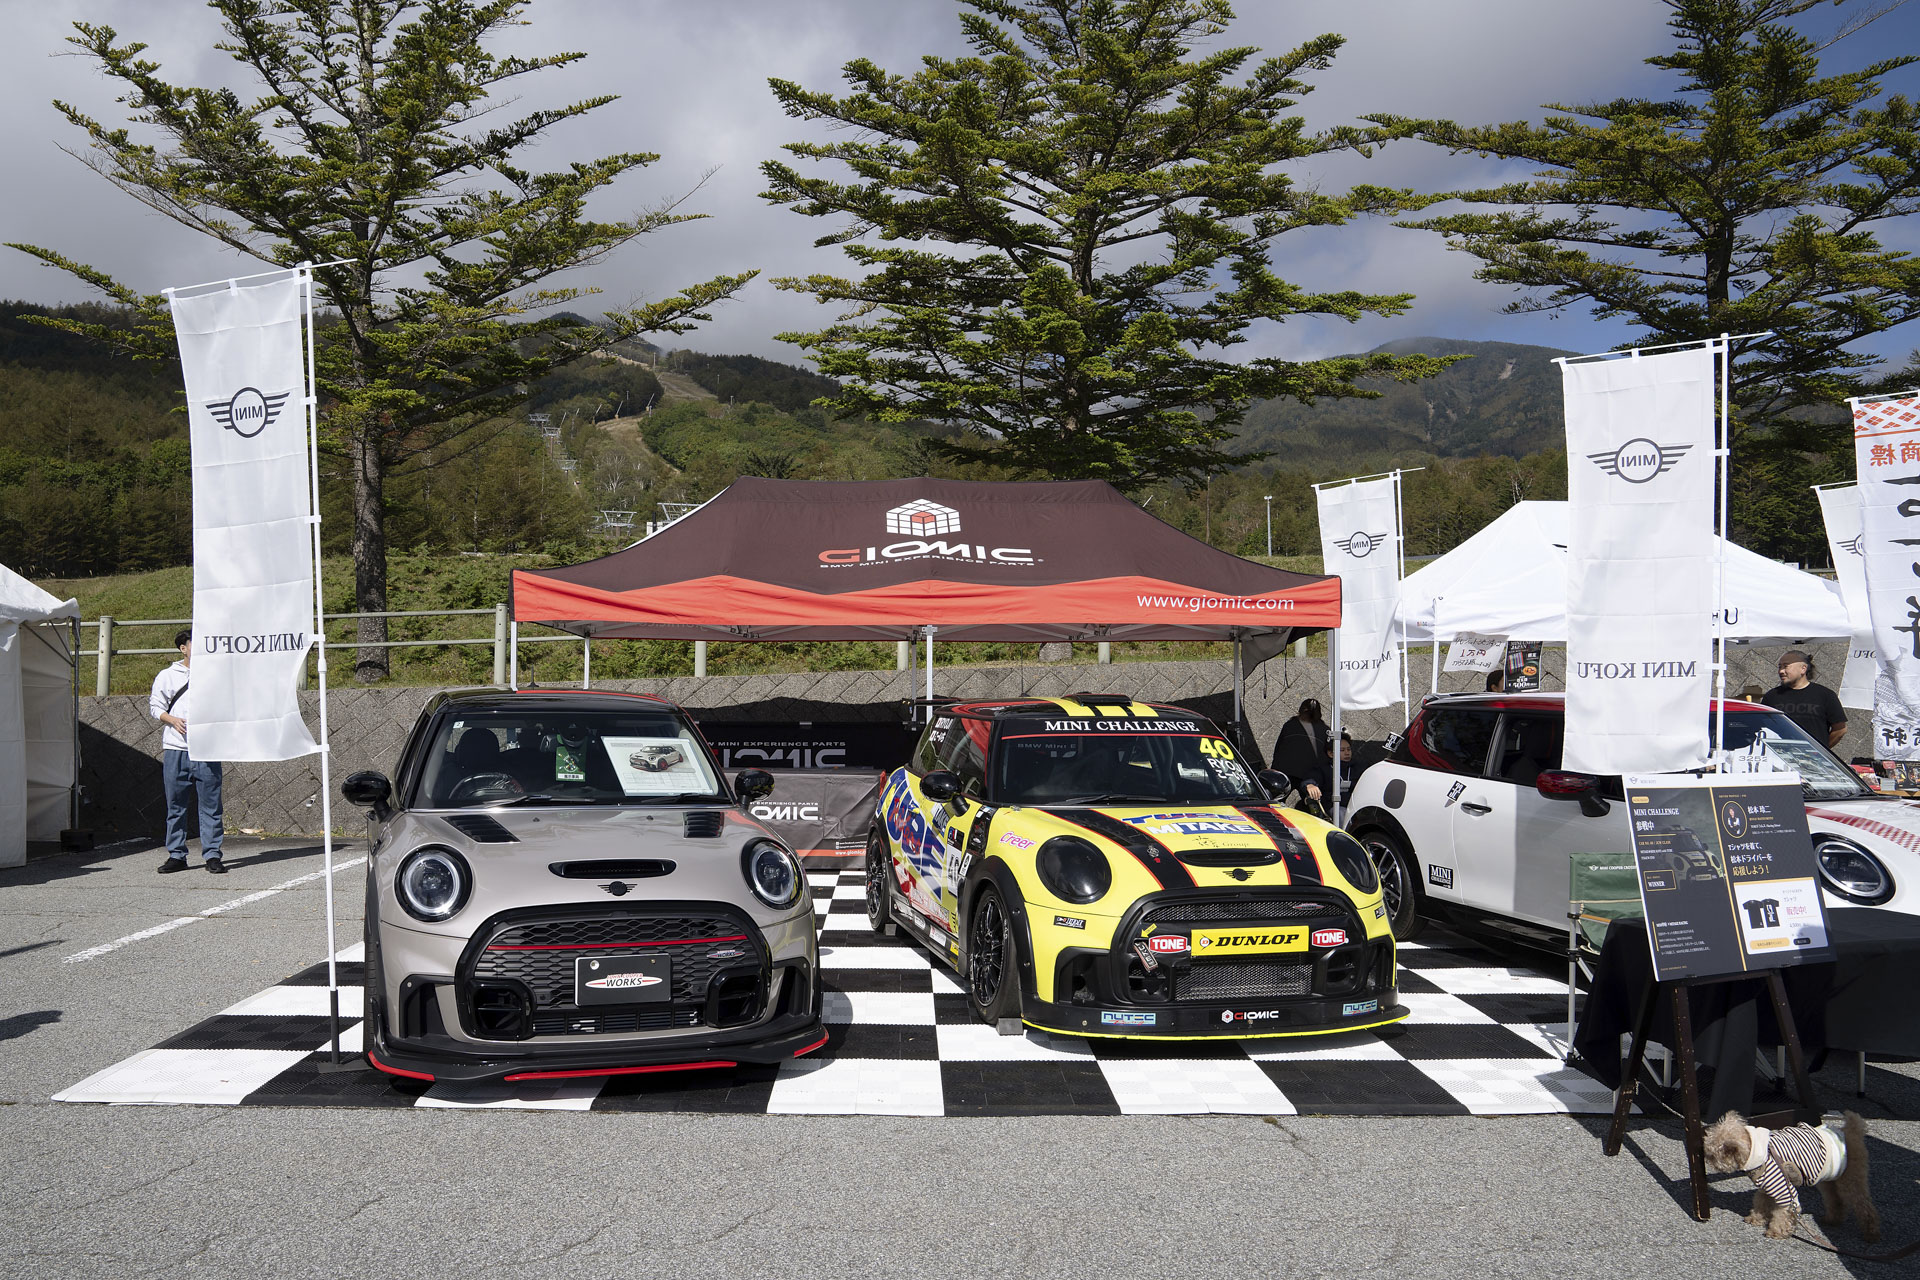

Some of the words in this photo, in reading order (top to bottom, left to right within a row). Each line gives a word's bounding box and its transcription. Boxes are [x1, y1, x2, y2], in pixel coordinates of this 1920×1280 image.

[818, 540, 1033, 563] GIOMIC
[894, 554, 984, 564] EXPERIENCE
[1137, 595, 1294, 612] www.giomic.com
[1045, 720, 1092, 731] MINI
[1096, 720, 1200, 732] CHALLENGE
[1200, 737, 1234, 760] 40
[751, 806, 819, 821] OMIC
[1633, 808, 1647, 816] MINI
[1145, 821, 1258, 835] MITAKE
[1000, 831, 1036, 850] Creer
[1430, 866, 1452, 880] MINI
[1152, 938, 1185, 950] TONE
[1215, 934, 1300, 947] DUNLOP
[1315, 932, 1344, 944] TONE
[606, 977, 642, 987] WORKS
[1103, 1013, 1155, 1021] NUTEC
[1234, 1010, 1280, 1020] GIOMIC
